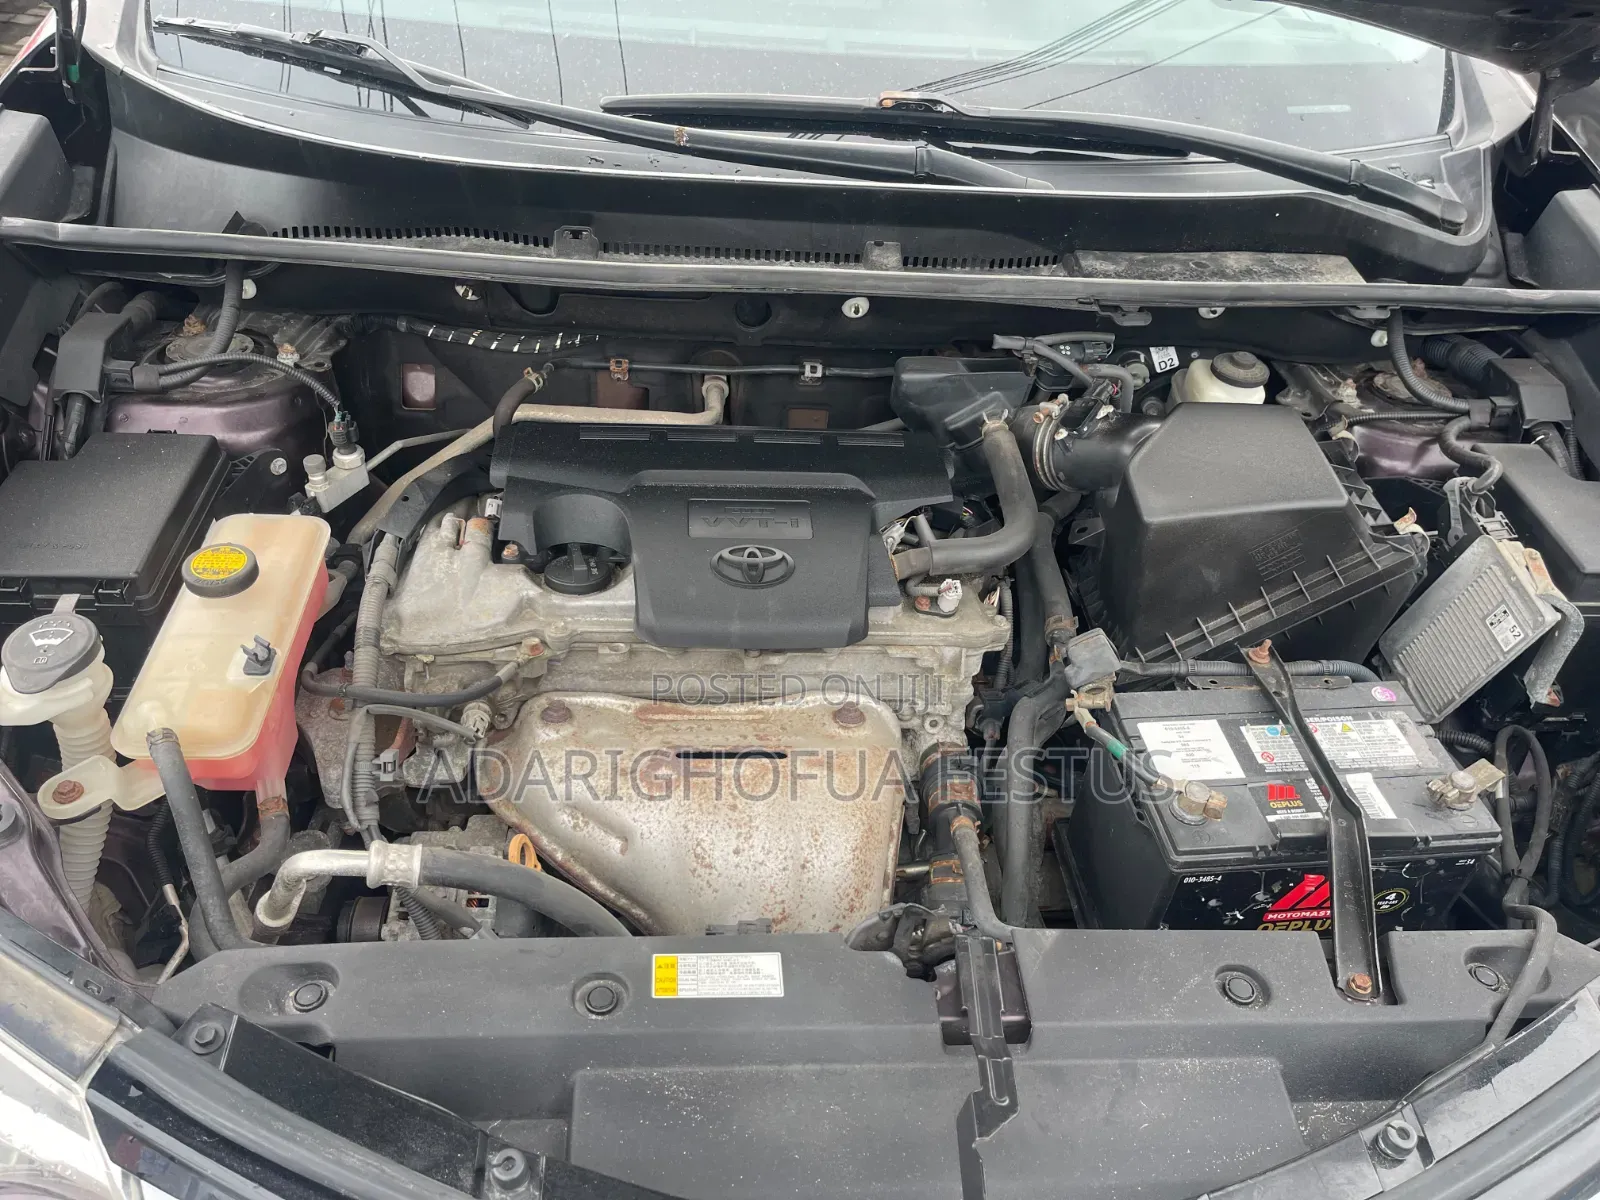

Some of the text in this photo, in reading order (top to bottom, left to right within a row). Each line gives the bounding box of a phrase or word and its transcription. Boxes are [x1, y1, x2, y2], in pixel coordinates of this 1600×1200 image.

[1158, 357, 1176, 371] D2
[1508, 624, 1522, 640] 52
[1267, 910, 1331, 920] MOTOMAST
